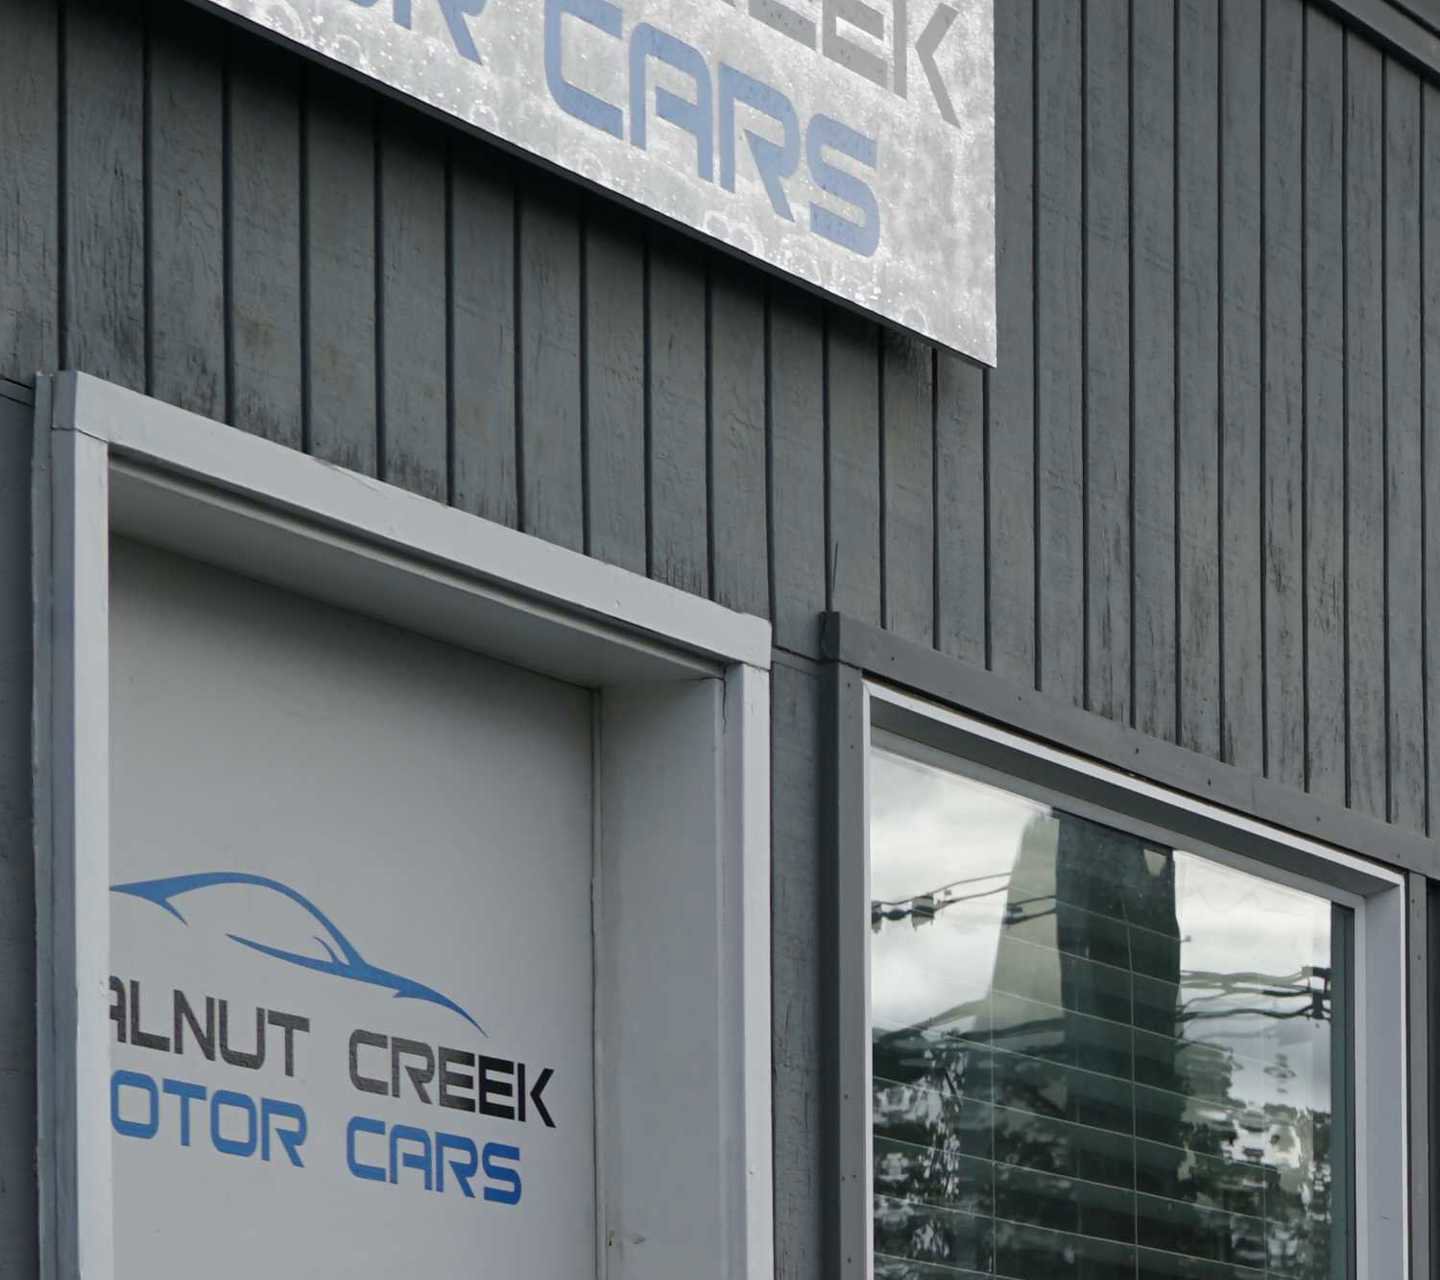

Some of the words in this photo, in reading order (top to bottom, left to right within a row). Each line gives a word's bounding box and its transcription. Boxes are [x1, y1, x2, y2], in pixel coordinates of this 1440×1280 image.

[544, 0, 881, 258] CARS
[109, 975, 310, 1077] LNUT
[349, 1029, 556, 1128] CREEK
[110, 1070, 307, 1168] OTOR
[346, 1116, 522, 1205] CARS
